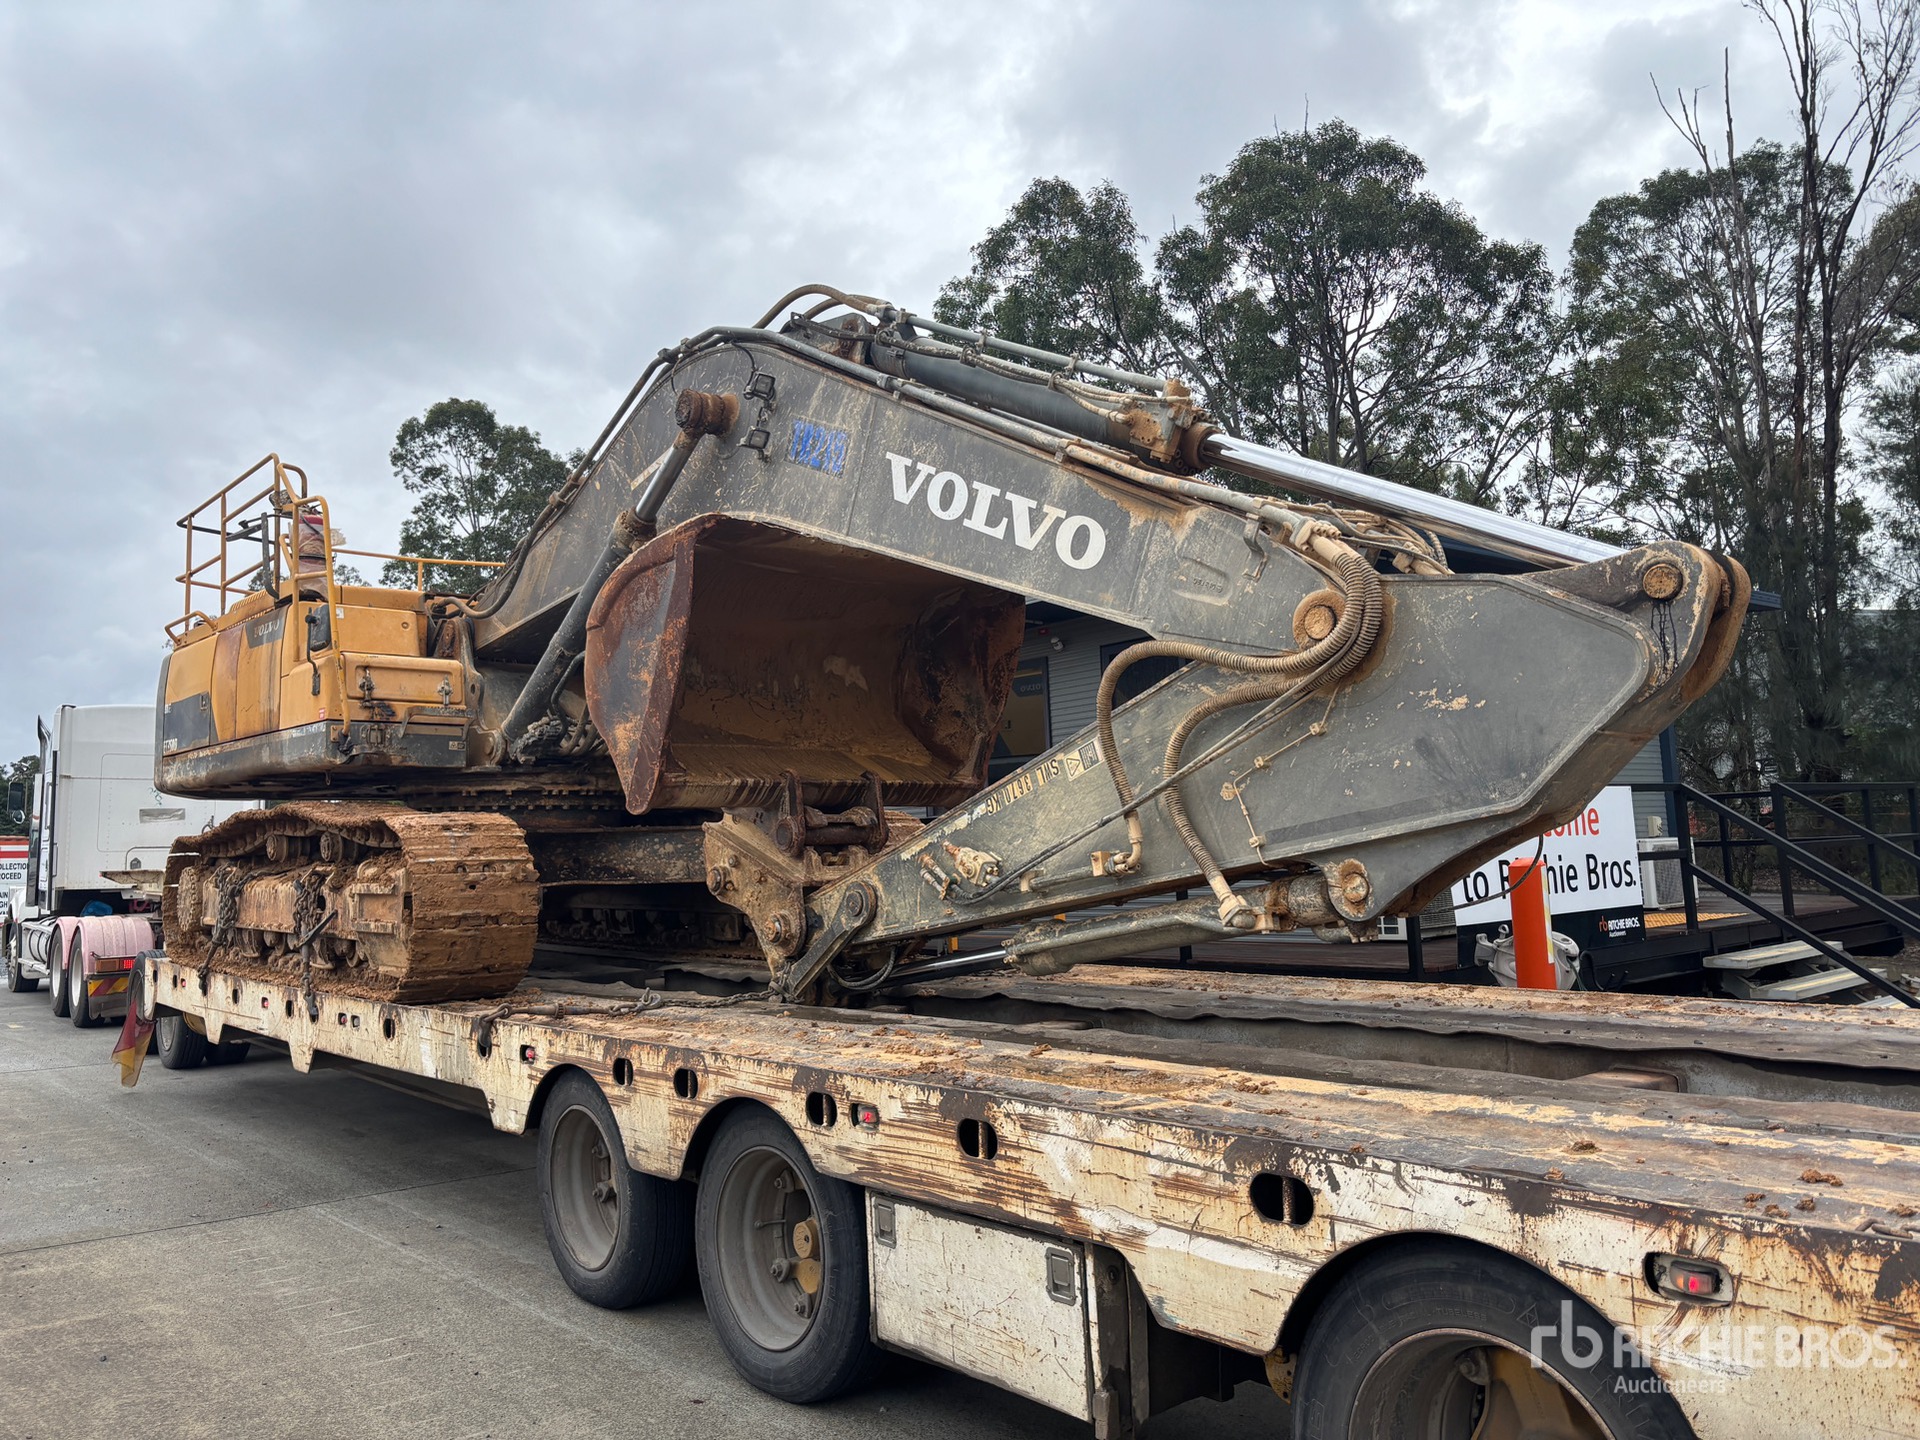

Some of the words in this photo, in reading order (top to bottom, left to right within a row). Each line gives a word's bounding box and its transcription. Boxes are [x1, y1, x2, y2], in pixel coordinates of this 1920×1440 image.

[886, 452, 1107, 569] VOLVO
[1035, 759, 1060, 783] SWL
[986, 793, 1002, 814] KG
[0, 872, 22, 880] OCEED
[1464, 870, 1490, 902] to
[1498, 852, 1578, 900] Rhie
[1586, 853, 1637, 891] Bros.
[1608, 919, 1626, 930] RITCHIE
